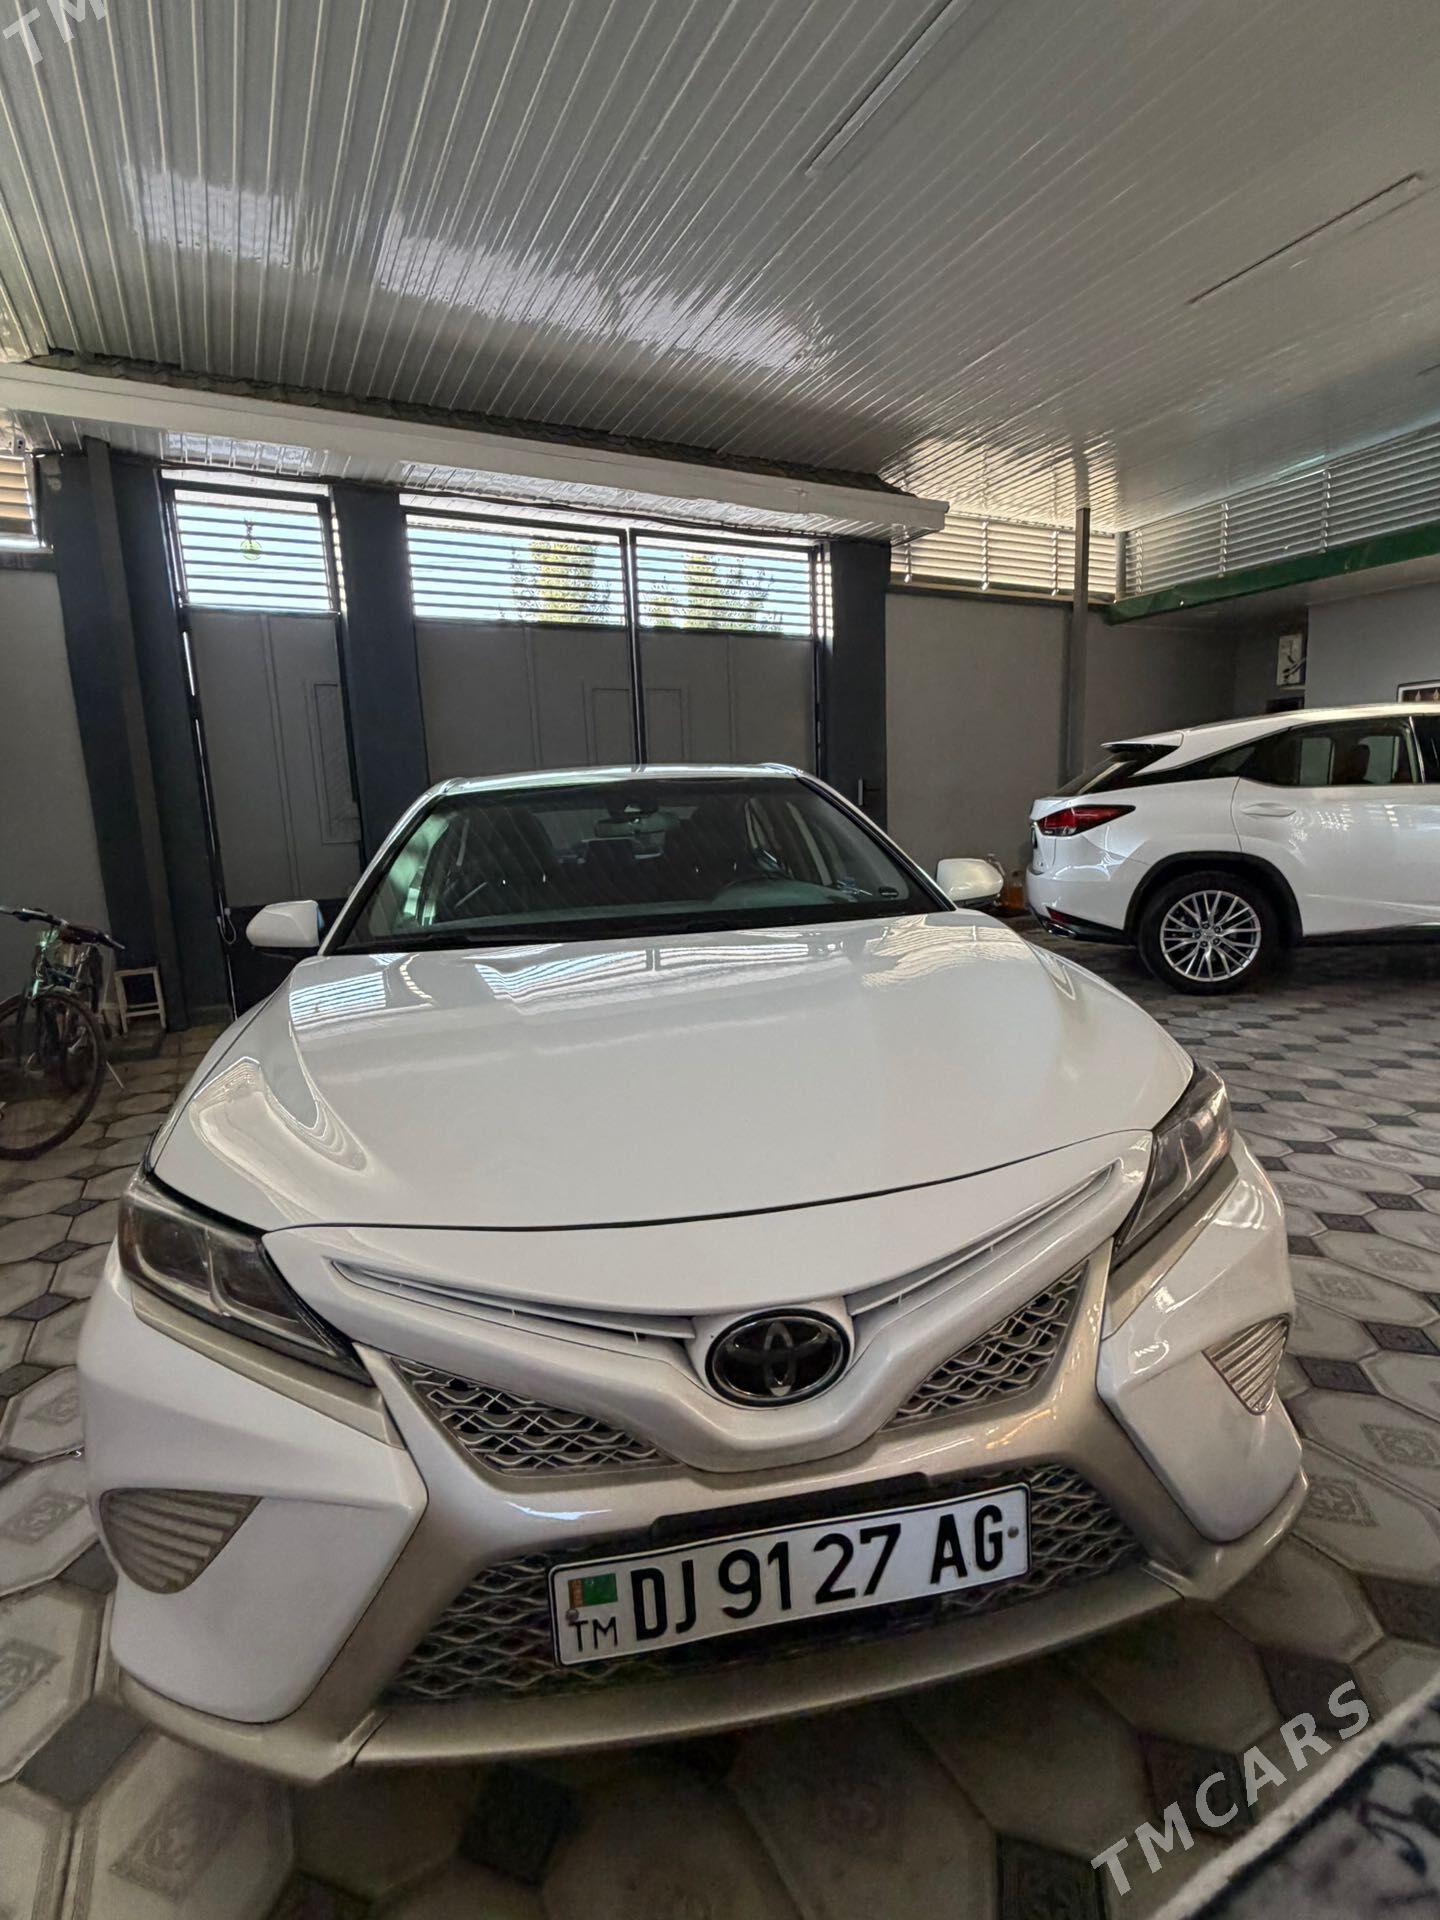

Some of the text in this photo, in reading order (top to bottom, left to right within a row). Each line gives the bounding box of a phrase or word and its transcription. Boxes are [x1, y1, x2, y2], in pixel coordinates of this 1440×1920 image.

[630, 1505, 1003, 1641] DJ 91 27 AG
[569, 1616, 618, 1652] TM
